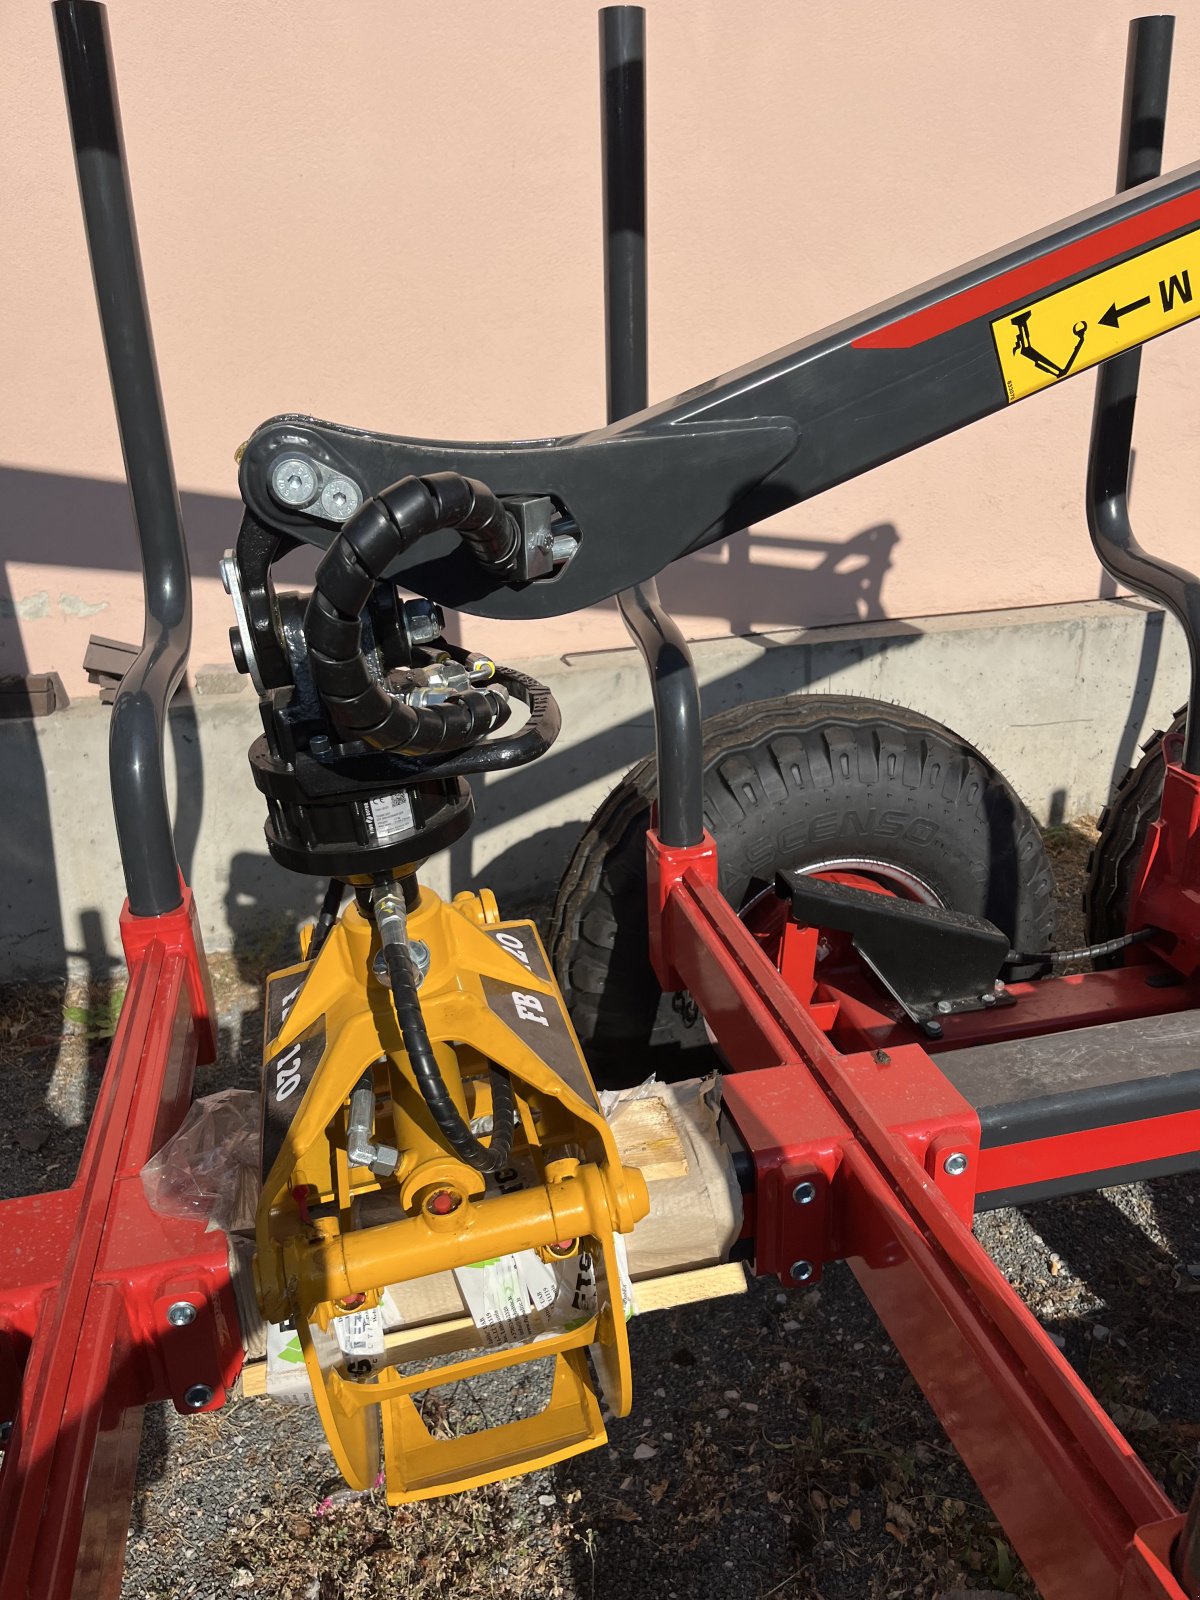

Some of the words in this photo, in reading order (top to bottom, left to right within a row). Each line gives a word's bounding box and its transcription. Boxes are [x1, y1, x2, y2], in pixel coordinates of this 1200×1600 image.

[1158, 269, 1193, 313] M
[721, 808, 940, 893] ASCENSO
[496, 932, 532, 975] 20
[511, 991, 550, 1028] FB
[276, 1043, 301, 1102] 120
